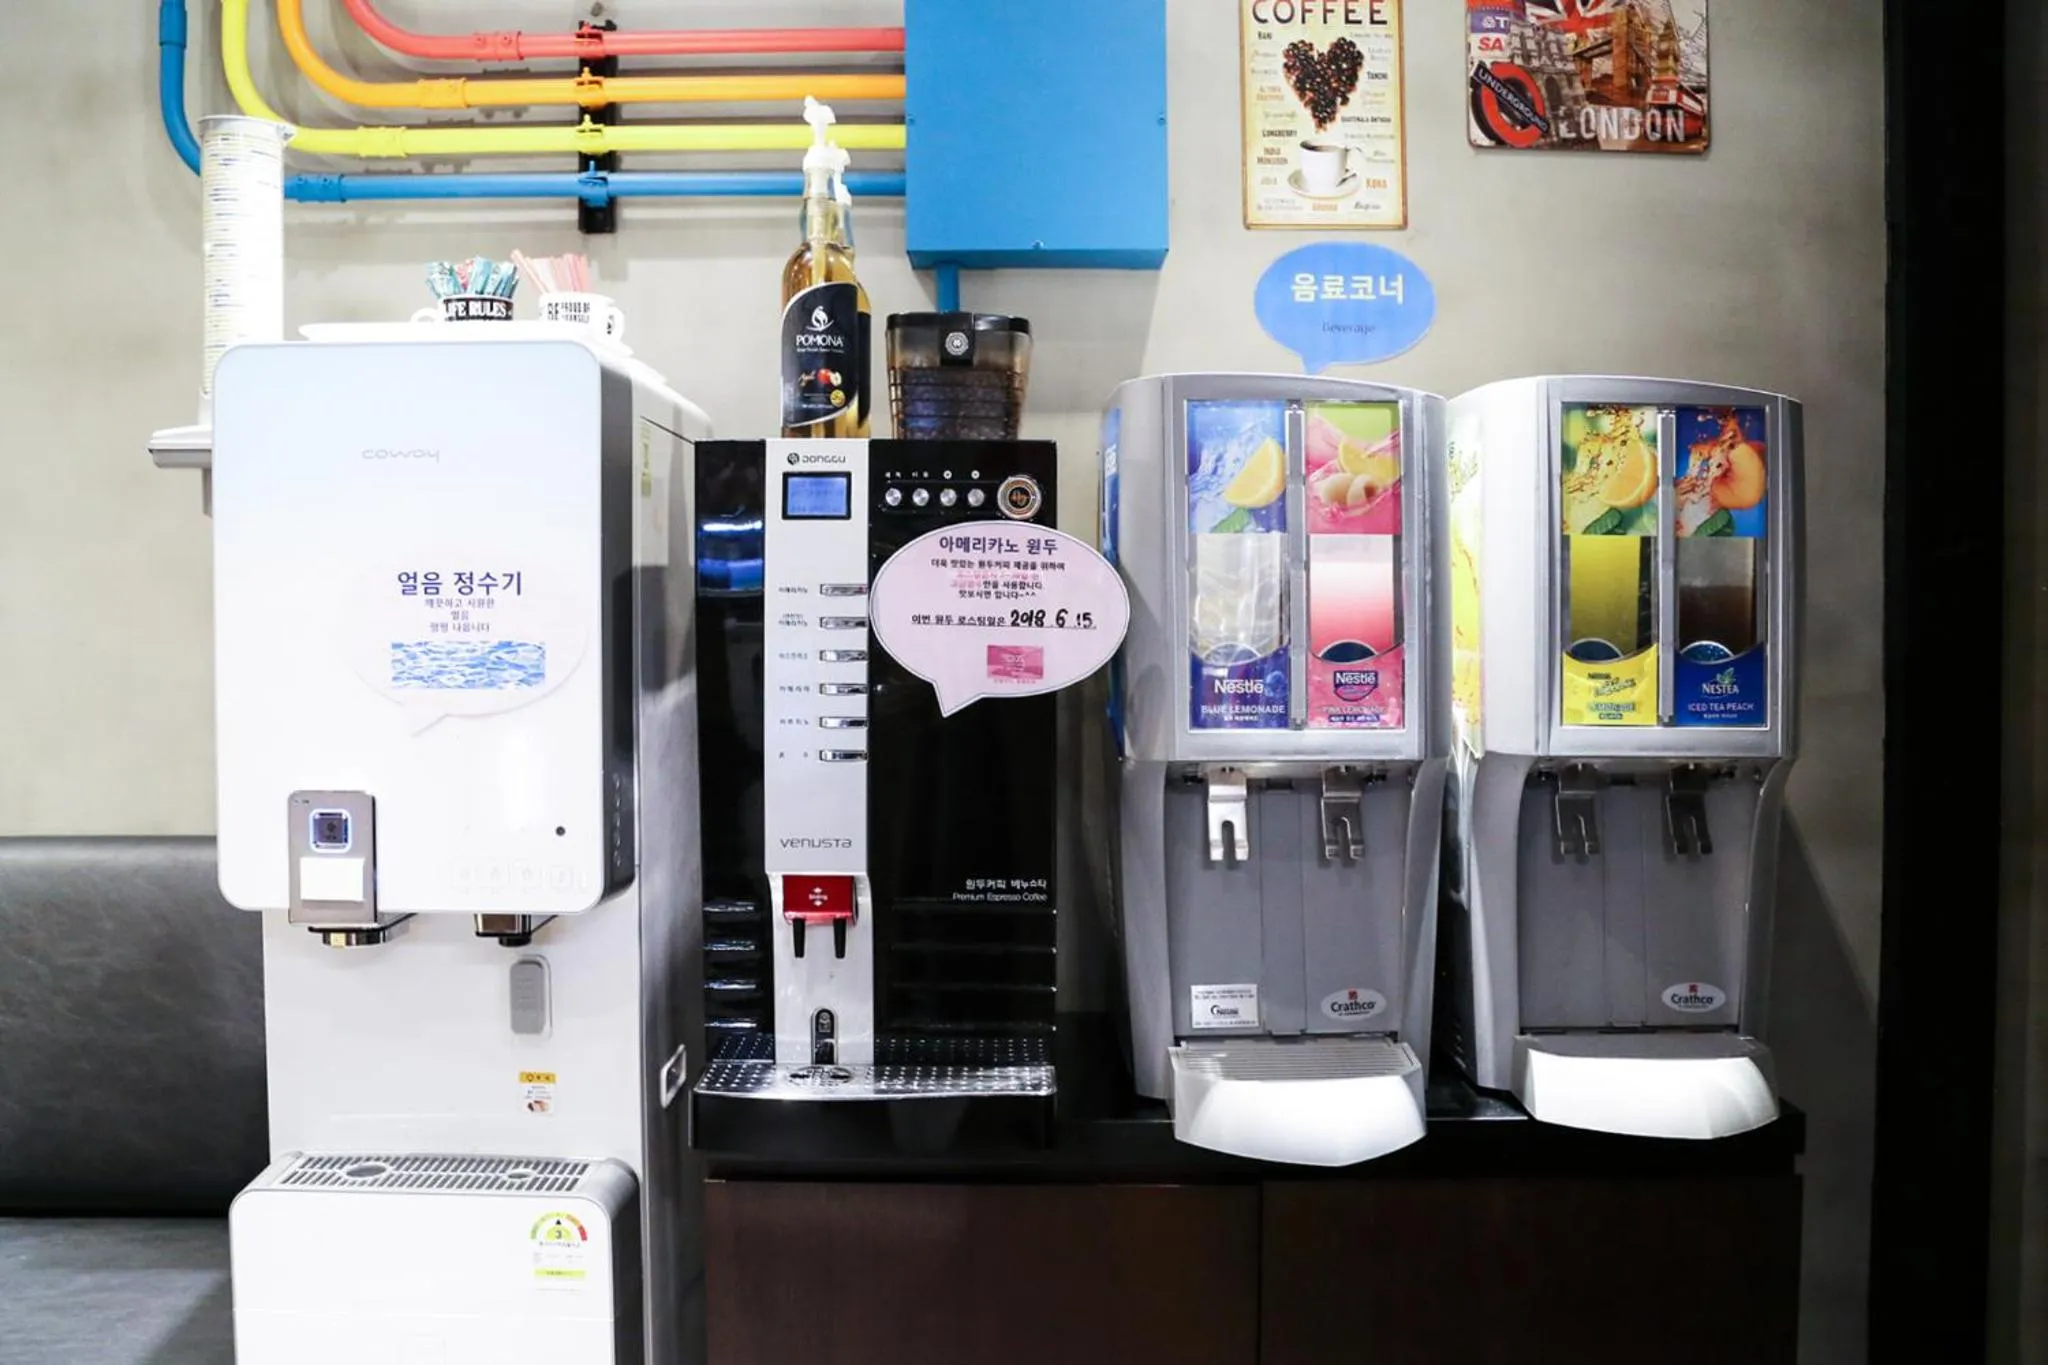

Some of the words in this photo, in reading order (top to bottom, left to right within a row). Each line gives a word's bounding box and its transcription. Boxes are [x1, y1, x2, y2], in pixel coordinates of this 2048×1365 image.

[1252, 0, 1388, 25] COFFEE
[1479, 36, 1504, 50] SA
[1477, 67, 1548, 133] UNDERGROUND
[1559, 104, 1685, 142] LONDON
[1290, 272, 1405, 305] 음료코너
[795, 334, 844, 347] POMONA
[939, 536, 1020, 553] 아메리카노
[1026, 538, 1059, 555] 원두
[978, 560, 1011, 570] 원두커피
[397, 571, 444, 596] 얼음
[453, 571, 523, 596] 정수기
[911, 614, 931, 626] 이번
[935, 615, 954, 626] 원두
[1702, 683, 1740, 695] NESTEA
[1201, 704, 1227, 714] BLUE
[1229, 704, 1286, 714] LEMONADE
[1687, 702, 1707, 712] ICED
[1709, 702, 1725, 711] TEA
[1726, 702, 1754, 711] PEACH
[952, 891, 985, 901] Premium
[986, 891, 1021, 902] Espresso
[1022, 891, 1048, 901] Coffee
[1670, 992, 1714, 1005] Crathco
[1330, 1000, 1376, 1014] Crathco
